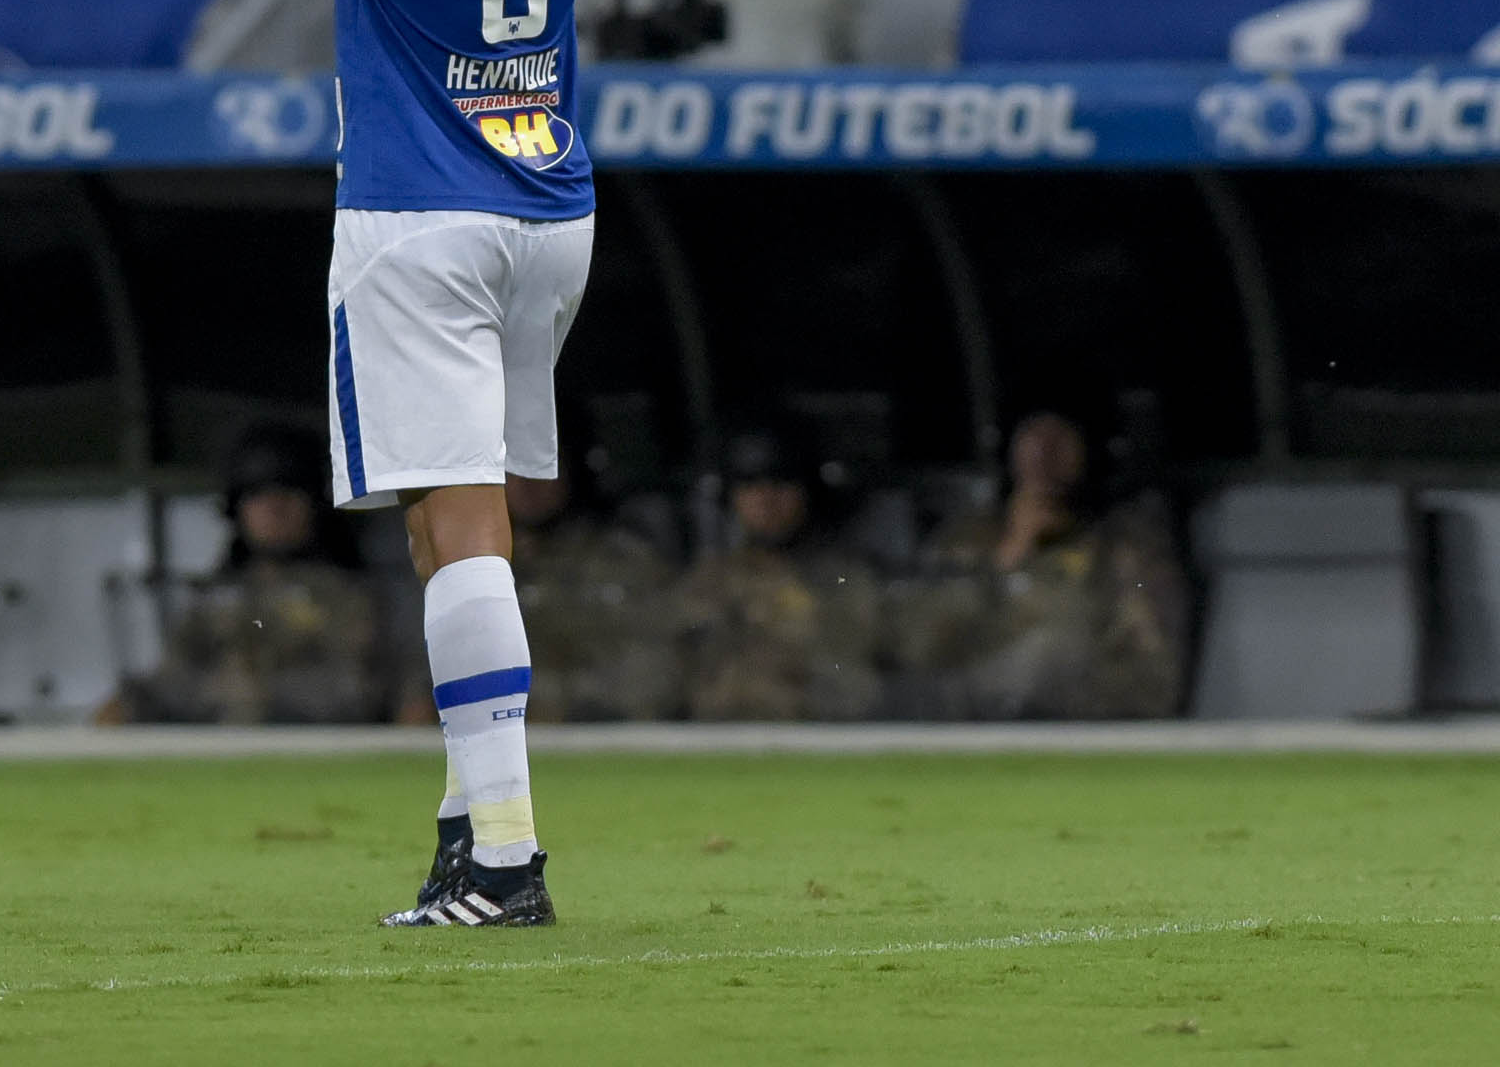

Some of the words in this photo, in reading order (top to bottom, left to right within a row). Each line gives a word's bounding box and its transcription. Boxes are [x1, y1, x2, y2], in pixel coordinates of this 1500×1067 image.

[446, 48, 559, 91] HENRIQUE
[479, 111, 559, 157] BH
[594, 82, 714, 158] DO
[726, 83, 1097, 159] FUTEBOL
